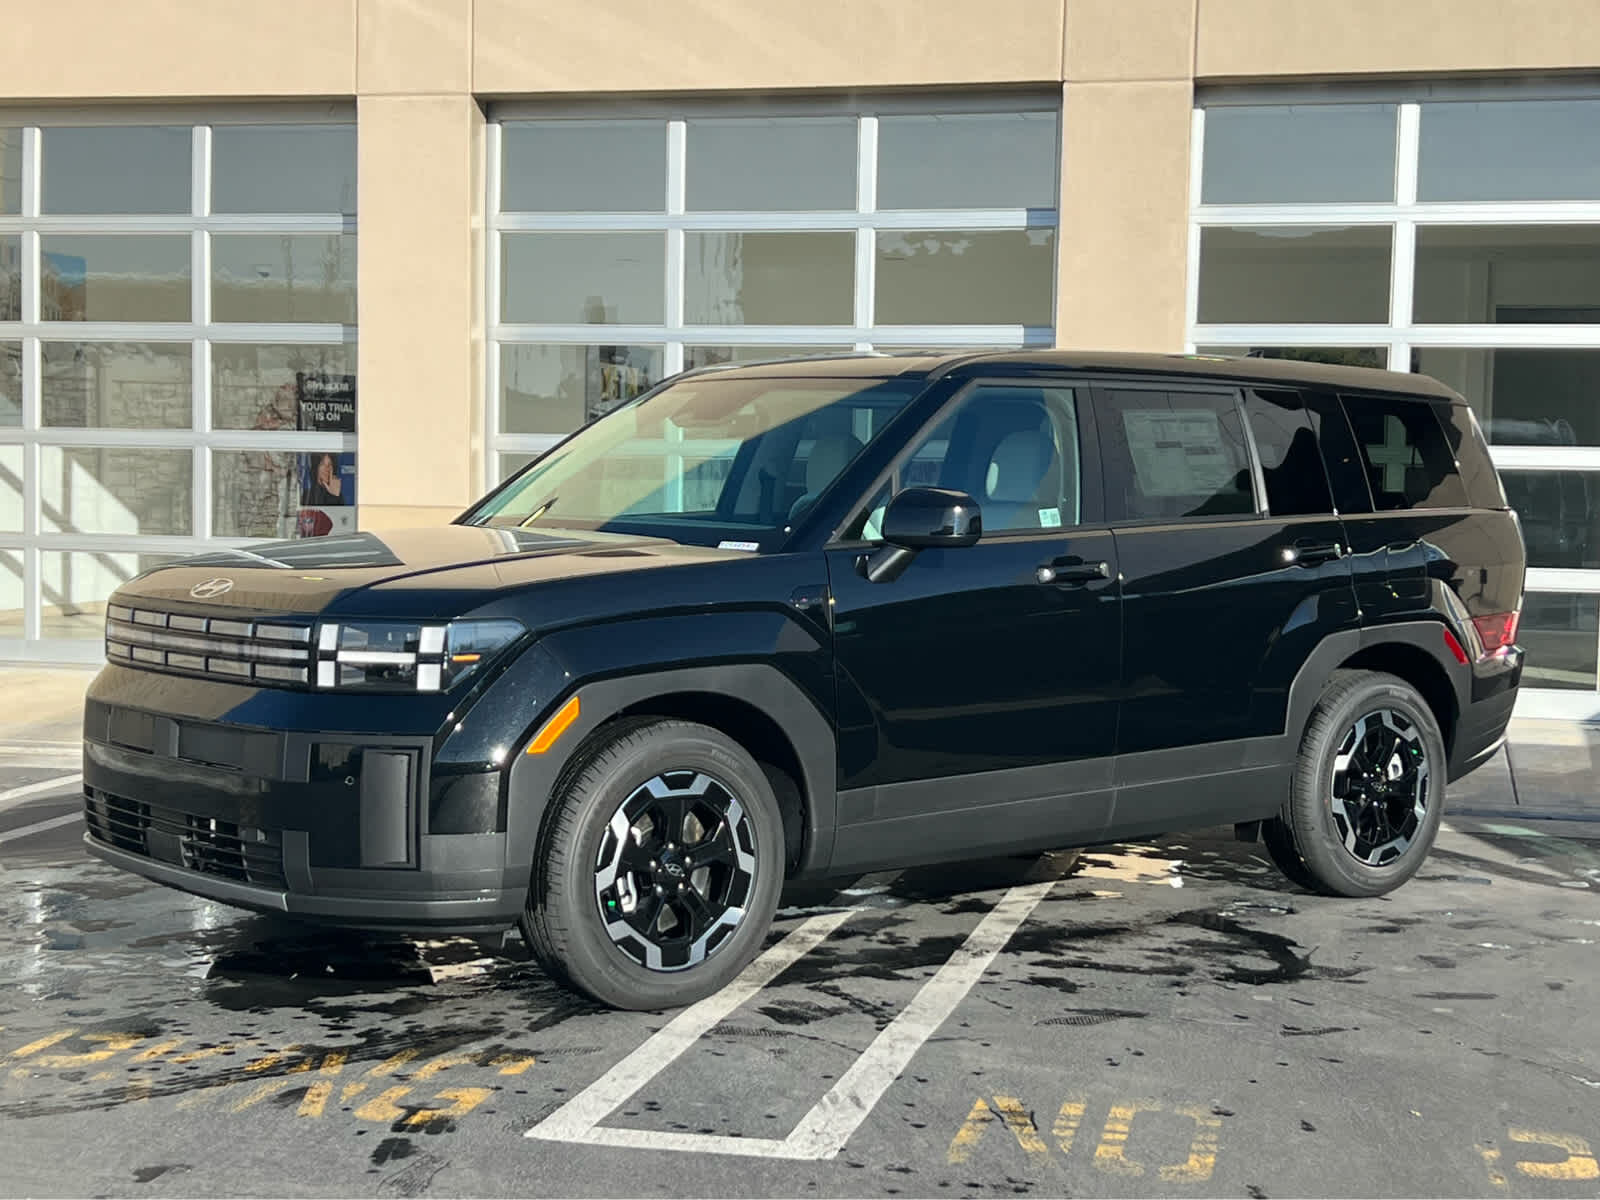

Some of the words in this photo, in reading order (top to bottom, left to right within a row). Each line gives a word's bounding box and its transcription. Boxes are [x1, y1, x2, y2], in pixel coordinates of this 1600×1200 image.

[300, 400, 327, 412] YOUR
[328, 402, 354, 414] TRIAL
[315, 411, 325, 421] IS
[326, 411, 341, 422] ON
[946, 1090, 1222, 1184] NO
